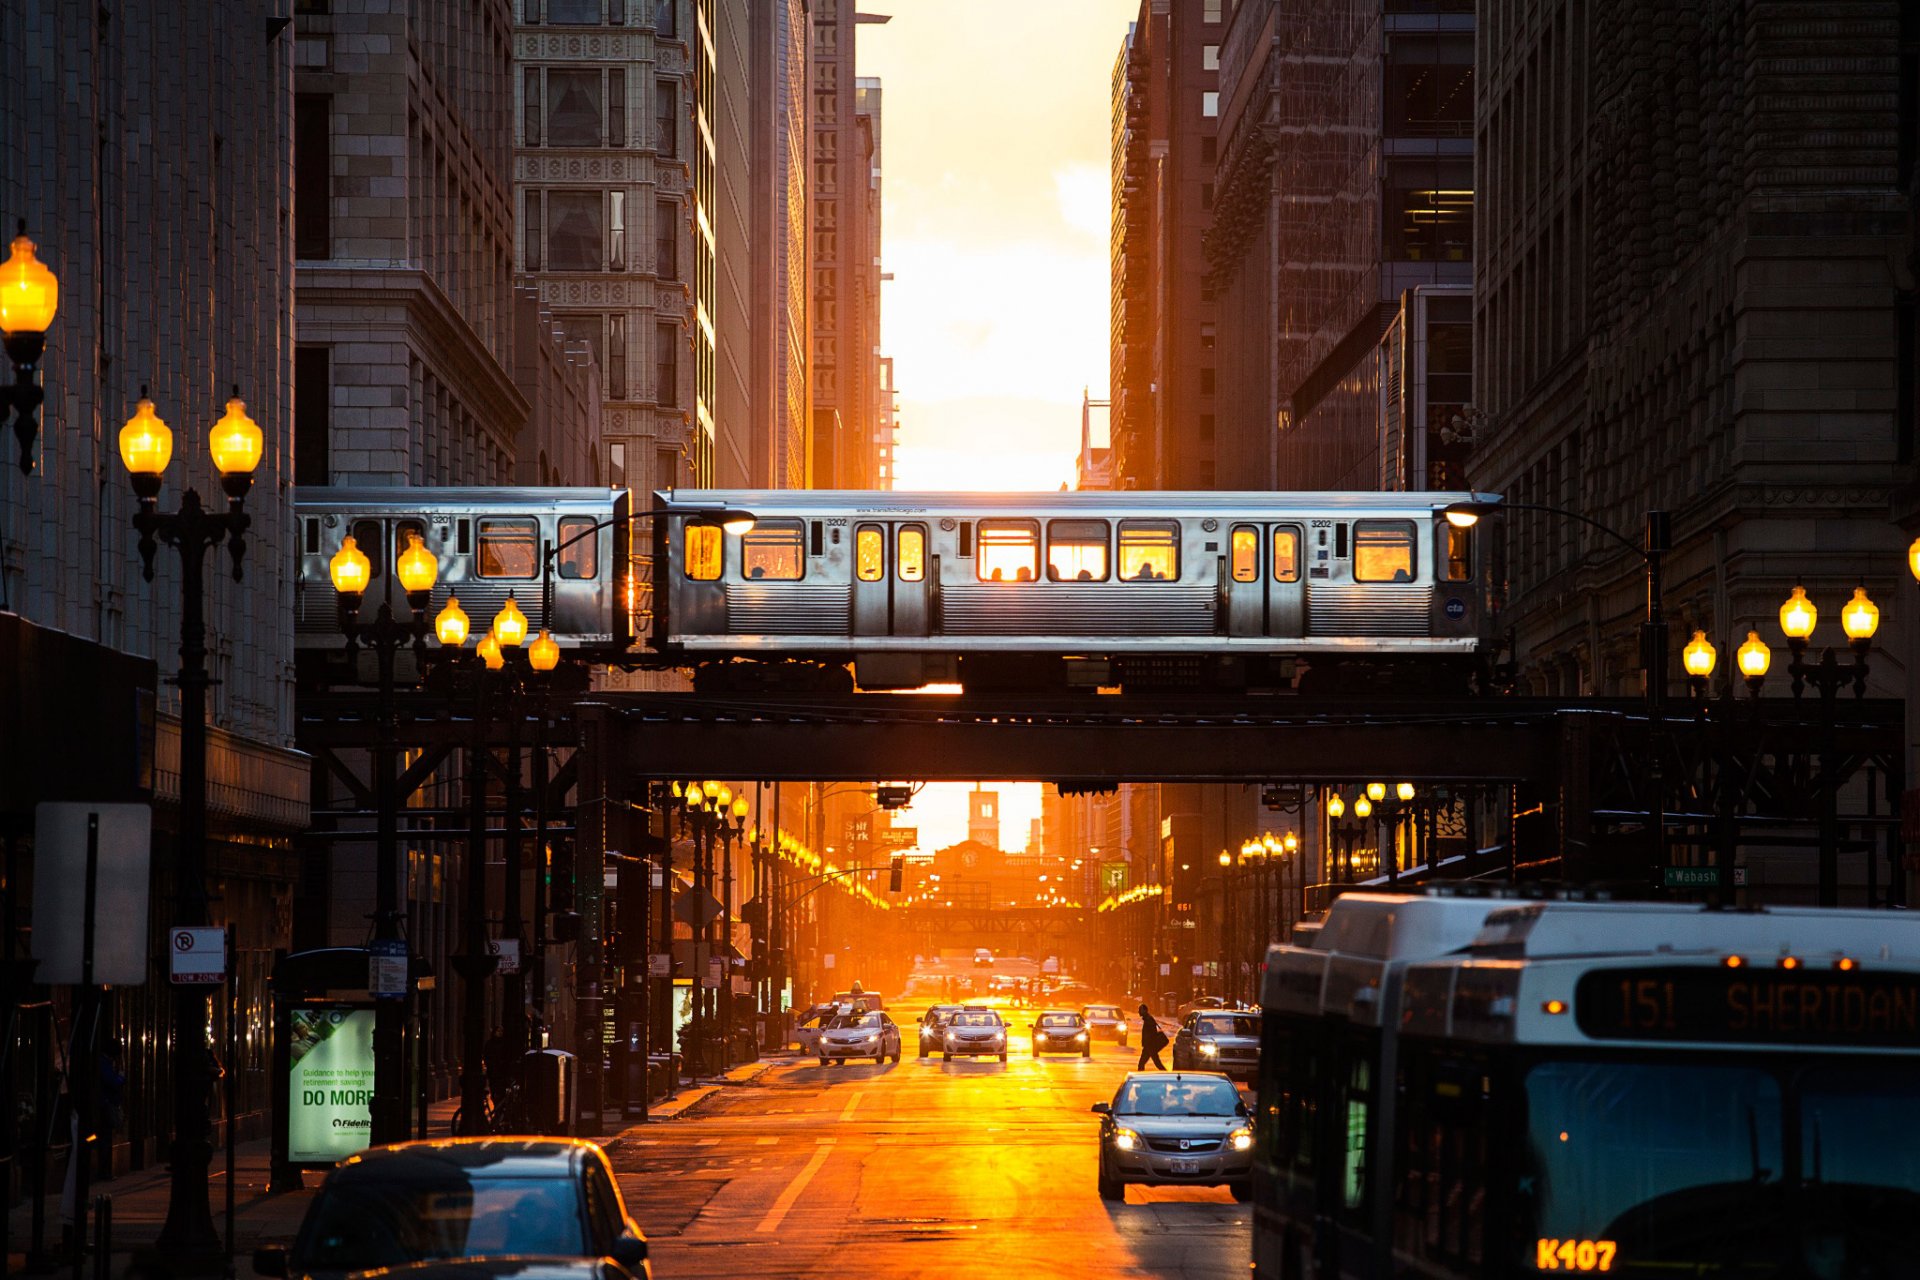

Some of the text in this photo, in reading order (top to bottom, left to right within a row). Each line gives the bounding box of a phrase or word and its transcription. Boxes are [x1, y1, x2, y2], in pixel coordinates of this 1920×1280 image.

[433, 515, 452, 524] 3201
[826, 518, 847, 527] 3202
[1311, 520, 1331, 528] 3202
[1446, 603, 1464, 613] cta
[1675, 870, 1716, 882] Wabash
[1618, 977, 1918, 1034] 151 SHERIDAN
[345, 1069, 360, 1078] help
[303, 1089, 325, 1106] DO
[1537, 1238, 1617, 1271] K407
